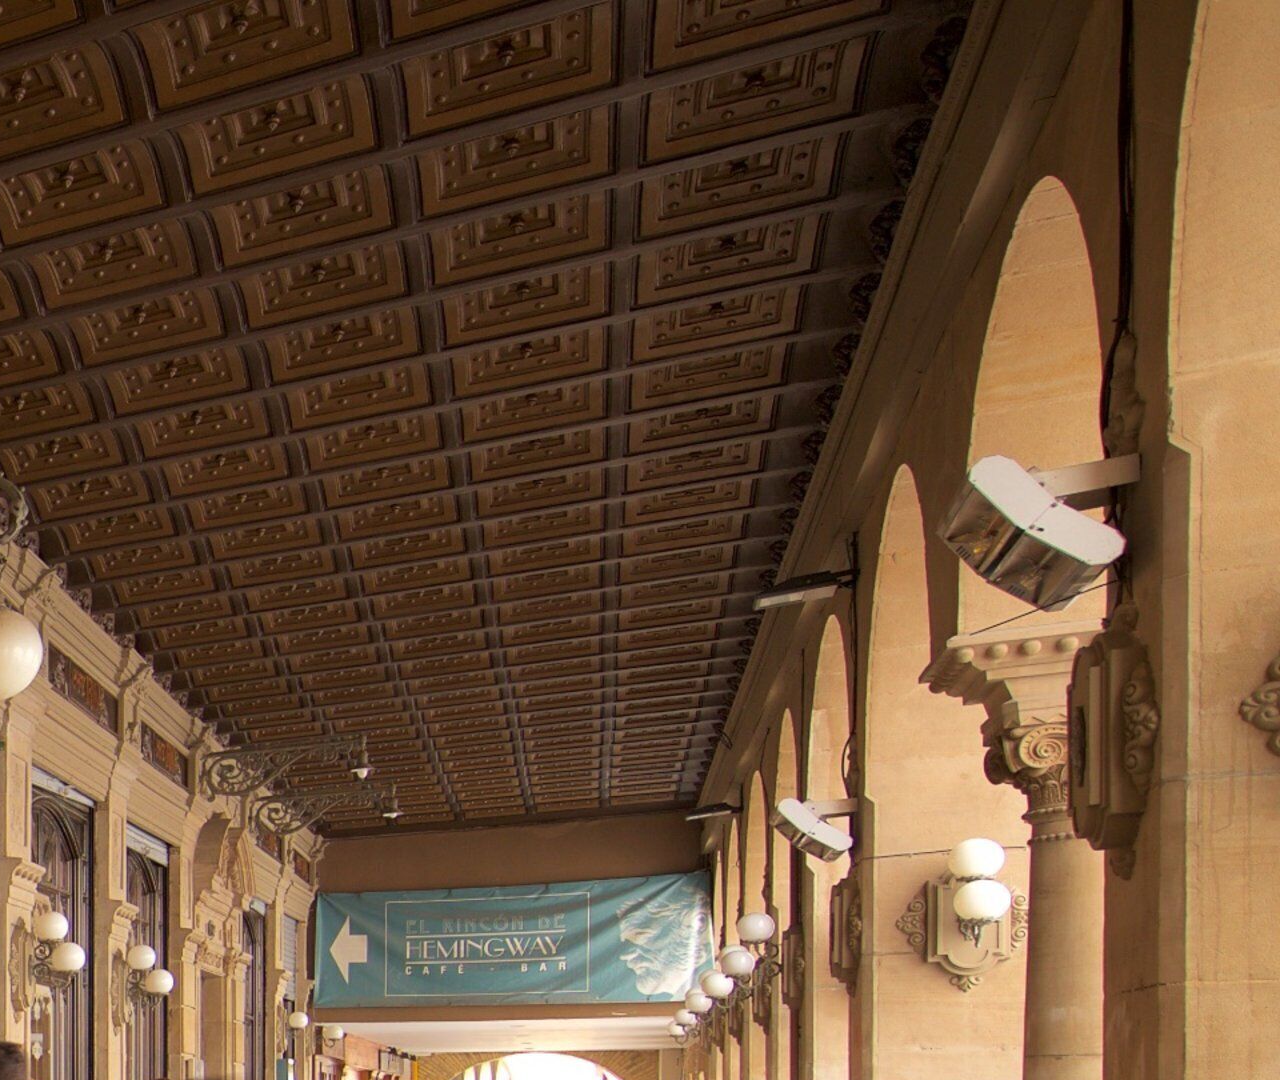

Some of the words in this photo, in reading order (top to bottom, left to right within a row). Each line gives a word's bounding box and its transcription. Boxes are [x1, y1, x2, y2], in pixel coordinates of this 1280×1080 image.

[406, 919, 430, 934] EL
[538, 913, 566, 929] DE
[405, 936, 564, 960] HEMINGWAY
[405, 964, 464, 975] CAFÉ
[520, 961, 567, 973] BAR
